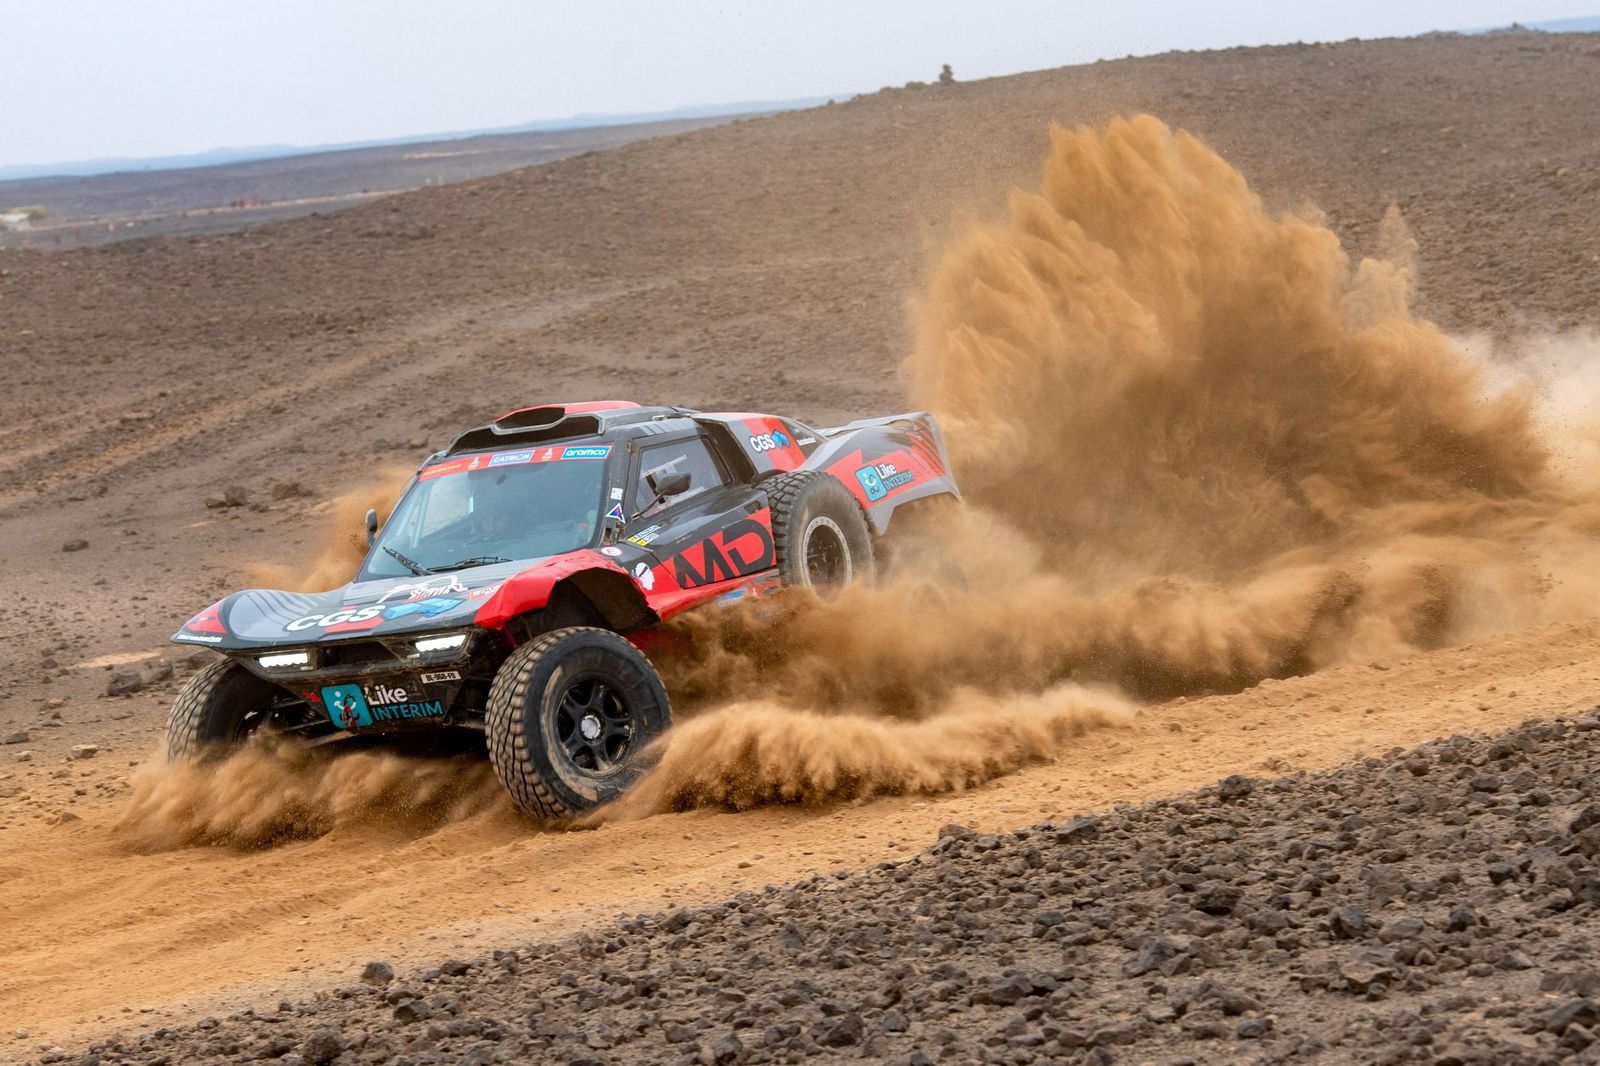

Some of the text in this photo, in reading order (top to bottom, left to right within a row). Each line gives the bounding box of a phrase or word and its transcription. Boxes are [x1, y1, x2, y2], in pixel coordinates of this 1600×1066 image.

[565, 447, 607, 456] aramco
[750, 433, 775, 452] CGS
[874, 463, 897, 480] Like
[884, 470, 914, 489] INTERIM
[286, 604, 386, 631] CGS
[364, 684, 408, 706] Like
[372, 701, 444, 721] INTERIM
